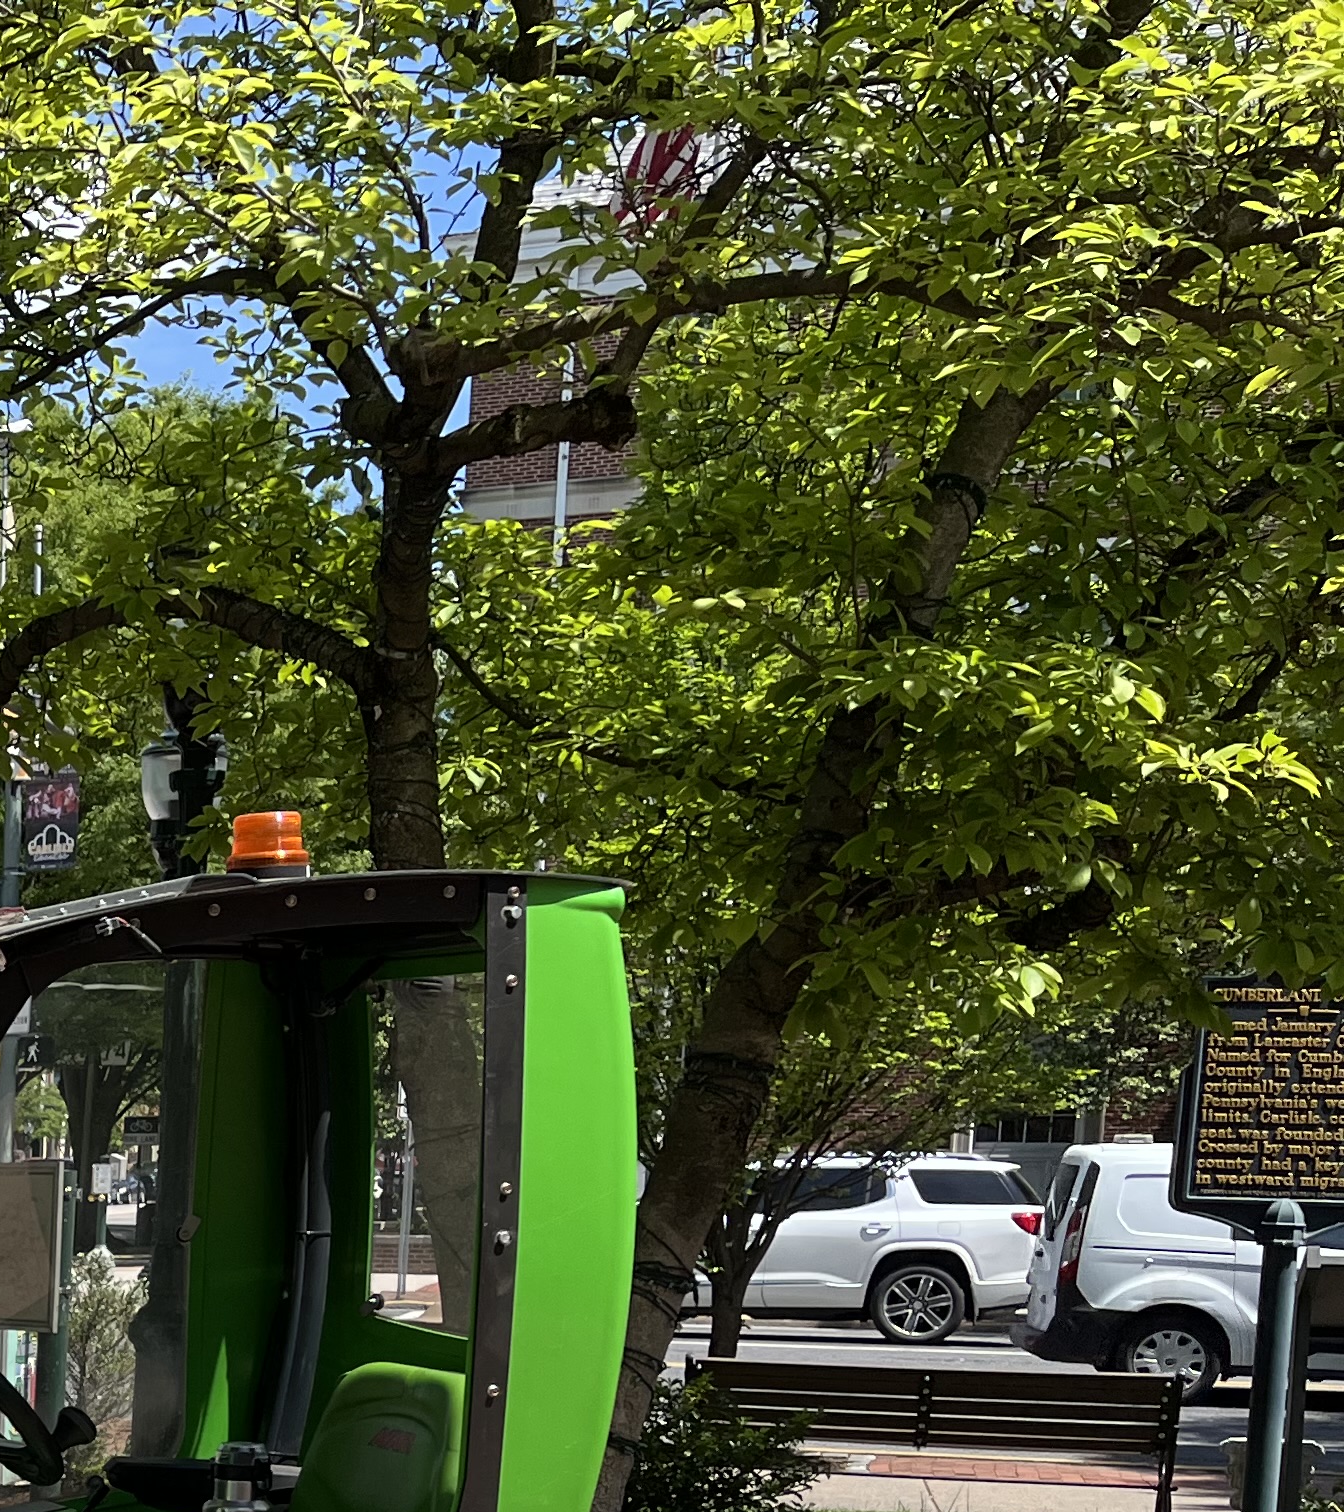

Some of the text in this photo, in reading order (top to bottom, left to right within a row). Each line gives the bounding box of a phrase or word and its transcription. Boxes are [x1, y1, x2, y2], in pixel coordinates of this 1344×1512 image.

[1271, 1016, 1337, 1036] January
[1254, 1033, 1331, 1047] Lancaster
[1207, 1048, 1261, 1062] Named
[1266, 1048, 1291, 1062] for
[1205, 1062, 1265, 1080] County
[1274, 1064, 1291, 1077] in
[1203, 1078, 1286, 1095] originally
[1201, 1093, 1318, 1111] Pennsylvania's
[1238, 1129, 1269, 1140] was
[1274, 1126, 1344, 1141] founded
[1197, 1139, 1259, 1153] Crossed
[1263, 1140, 1284, 1157] by
[1287, 1141, 1335, 1158] major
[1196, 1156, 1344, 1176] county had a key
[1195, 1169, 1212, 1185] in
[1216, 1172, 1295, 1187] westward
